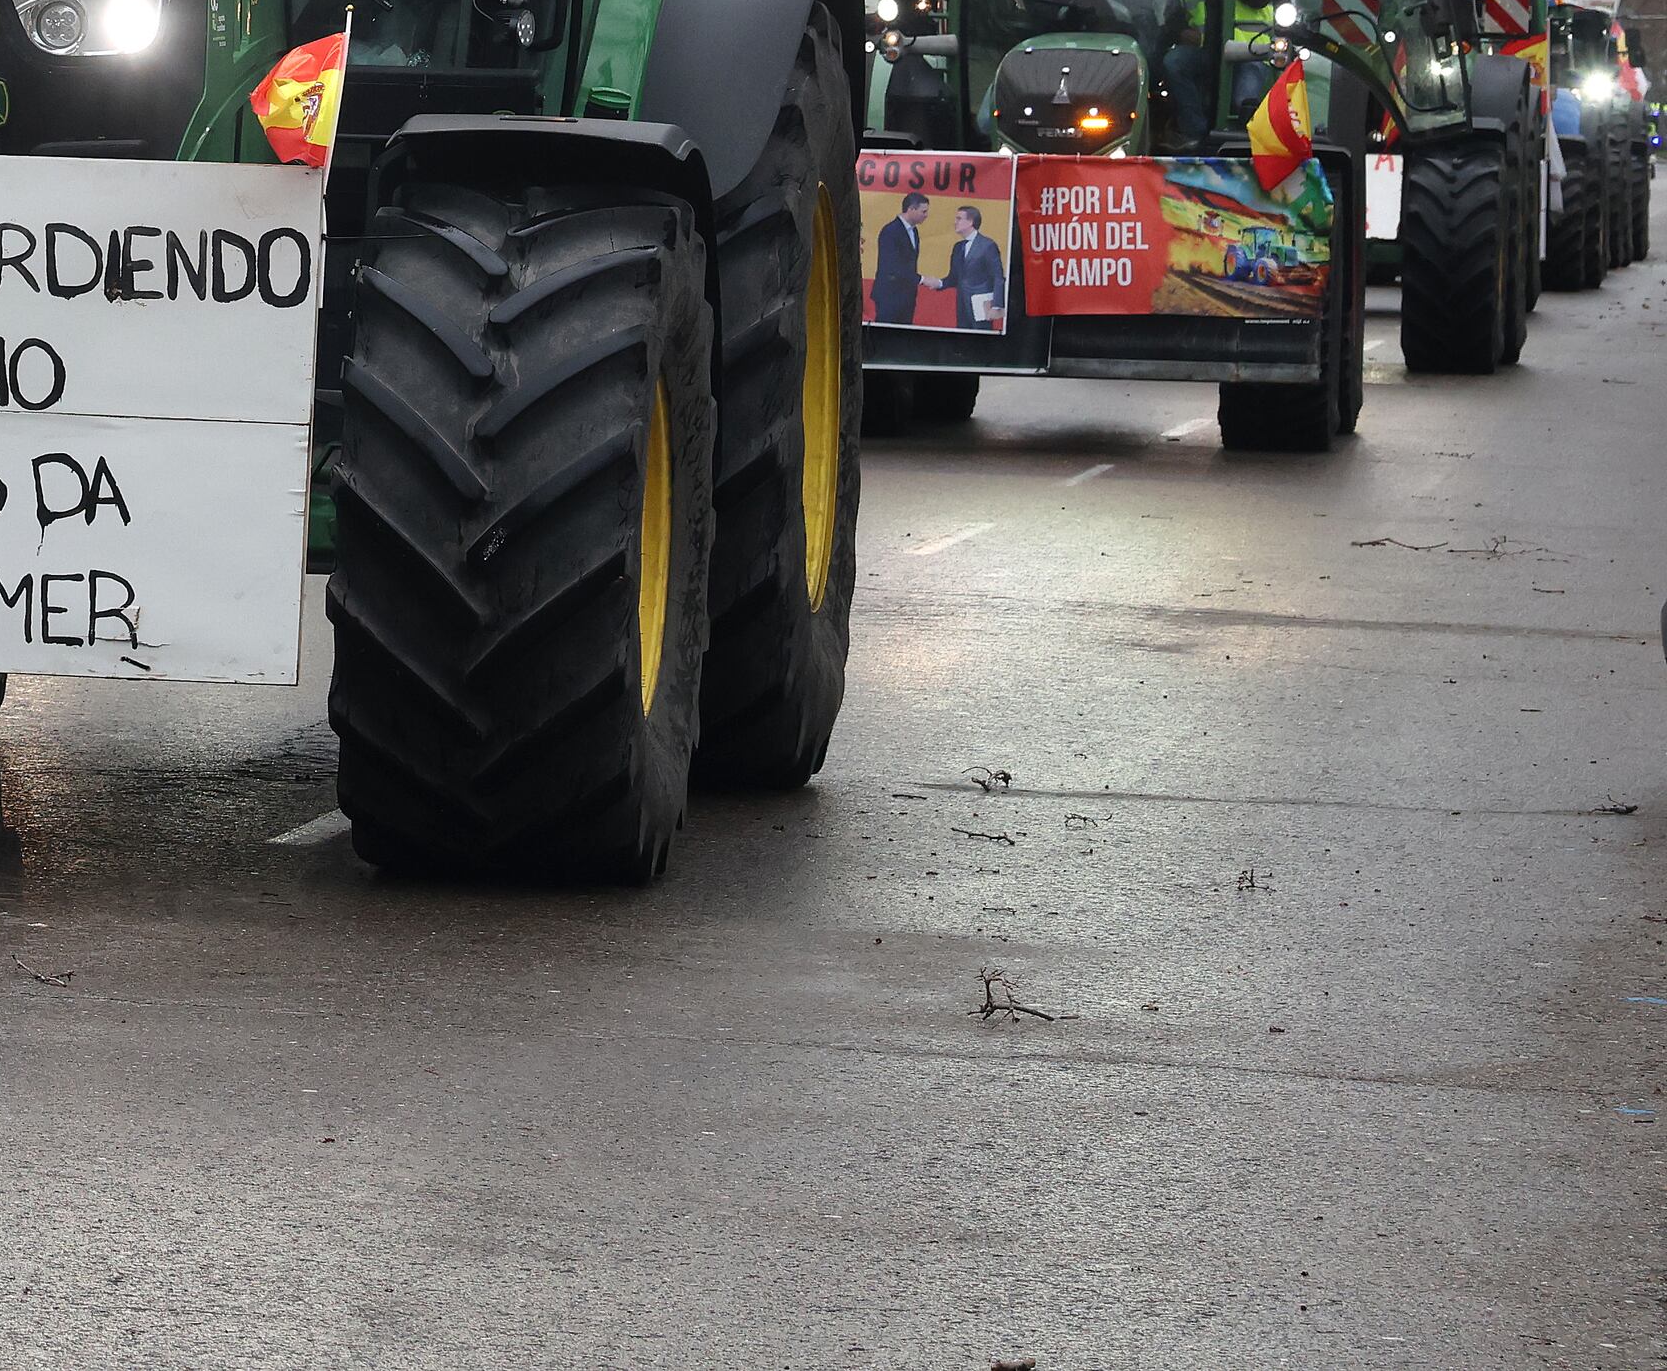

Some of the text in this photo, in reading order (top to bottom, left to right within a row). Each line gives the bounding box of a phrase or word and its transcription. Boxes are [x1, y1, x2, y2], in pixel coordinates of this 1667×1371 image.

[858, 159, 977, 194] COSUR
[1040, 185, 1138, 216] #POR LA
[1030, 216, 1150, 253] UNIÓN DEL
[1051, 257, 1133, 288] CAMPO
[32, 452, 131, 527] DA
